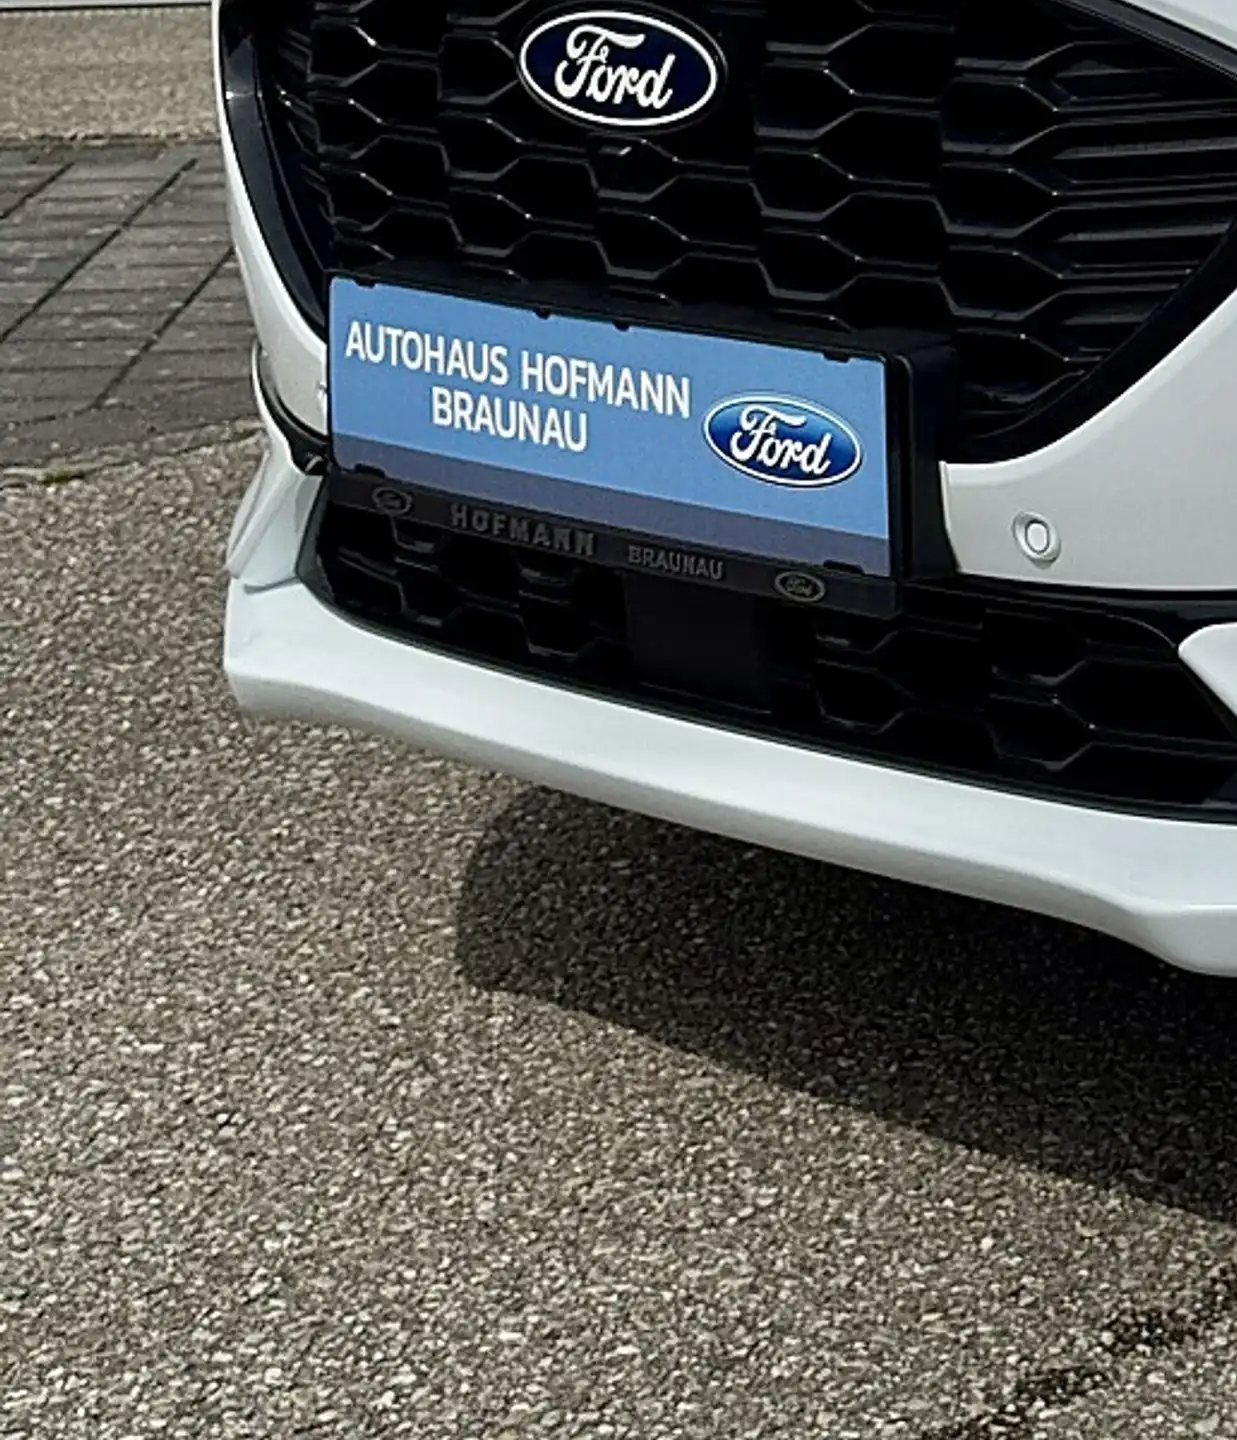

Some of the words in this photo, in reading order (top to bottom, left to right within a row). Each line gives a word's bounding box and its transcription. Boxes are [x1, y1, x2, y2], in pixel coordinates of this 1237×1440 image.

[554, 24, 676, 109] Ford
[345, 321, 508, 386] AUTOHAUS
[521, 350, 690, 419] HOFMANN
[431, 386, 589, 453] BRAUNAU
[730, 406, 830, 475] Ford
[451, 505, 596, 556] HOFMANN
[627, 545, 723, 582] BRAUNAU
